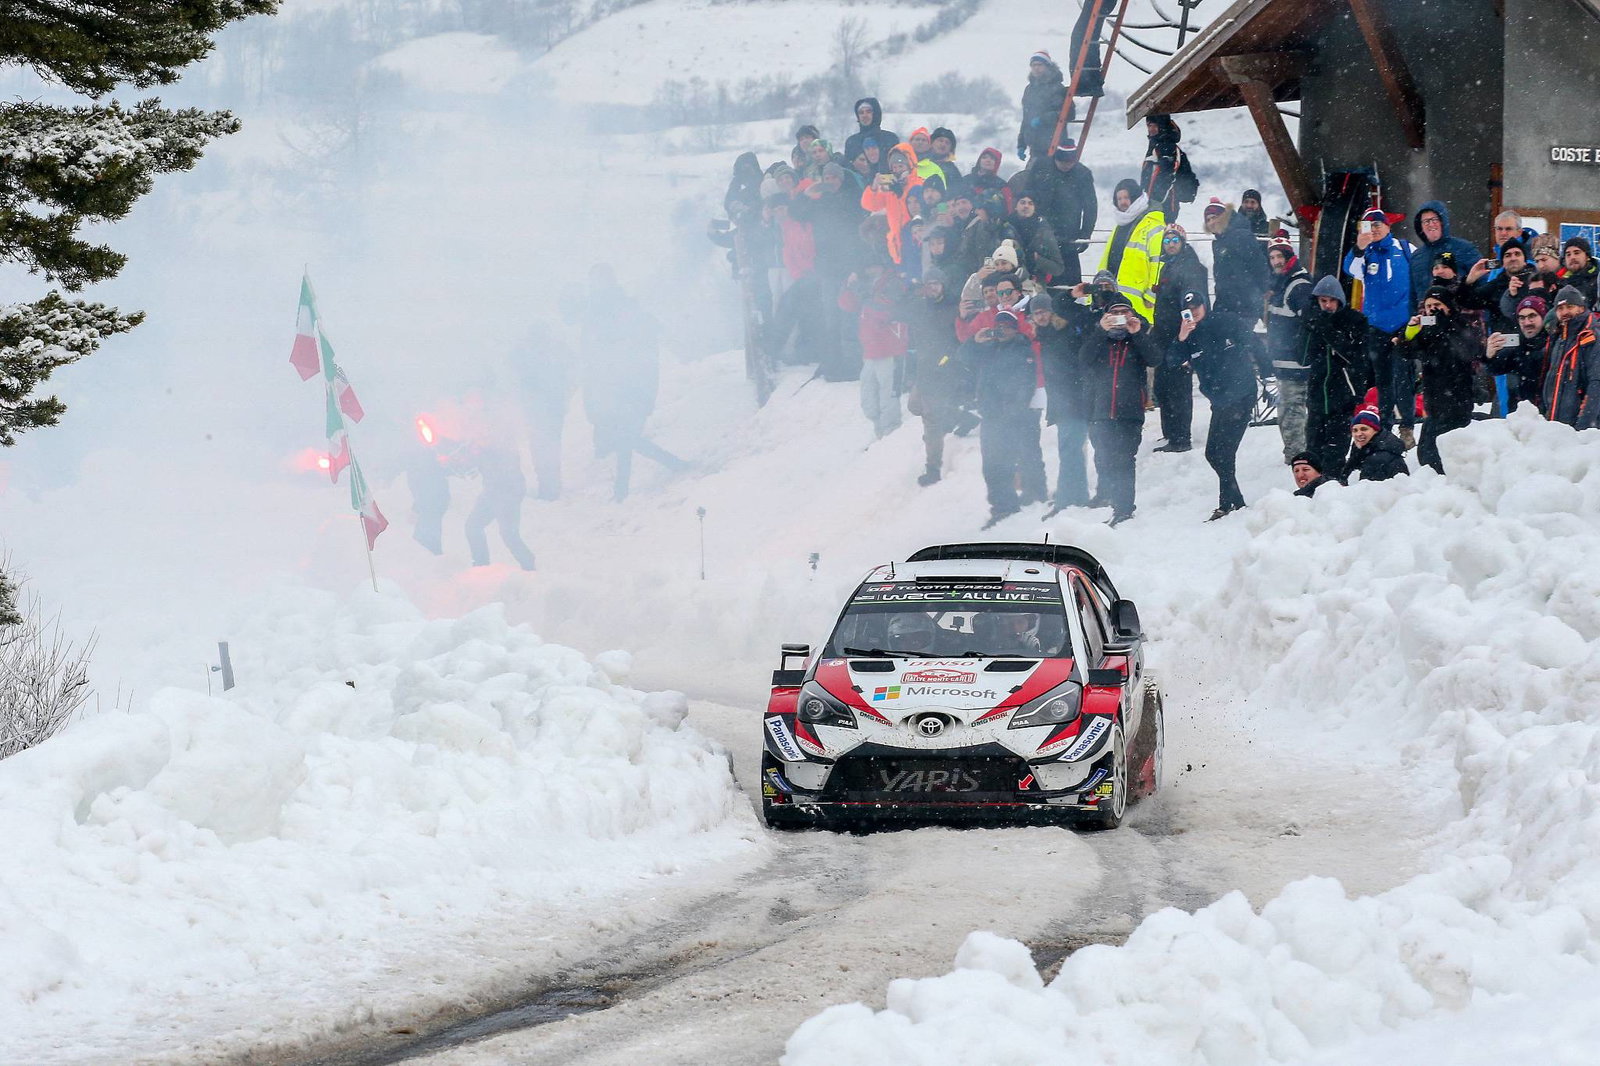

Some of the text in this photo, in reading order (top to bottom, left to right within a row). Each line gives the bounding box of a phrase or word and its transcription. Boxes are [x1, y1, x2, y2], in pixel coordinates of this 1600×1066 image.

[1551, 147, 1591, 162] COSTE
[1003, 584, 1051, 592] Racing
[962, 592, 992, 600] ALL
[996, 593, 1030, 601] LIVE
[907, 687, 997, 700] Microsoft
[837, 719, 854, 727] PIAA
[970, 719, 989, 728] DMG
[769, 719, 800, 760] Panasonic
[1063, 720, 1106, 761] Panasonic
[1095, 785, 1112, 794] OMP
